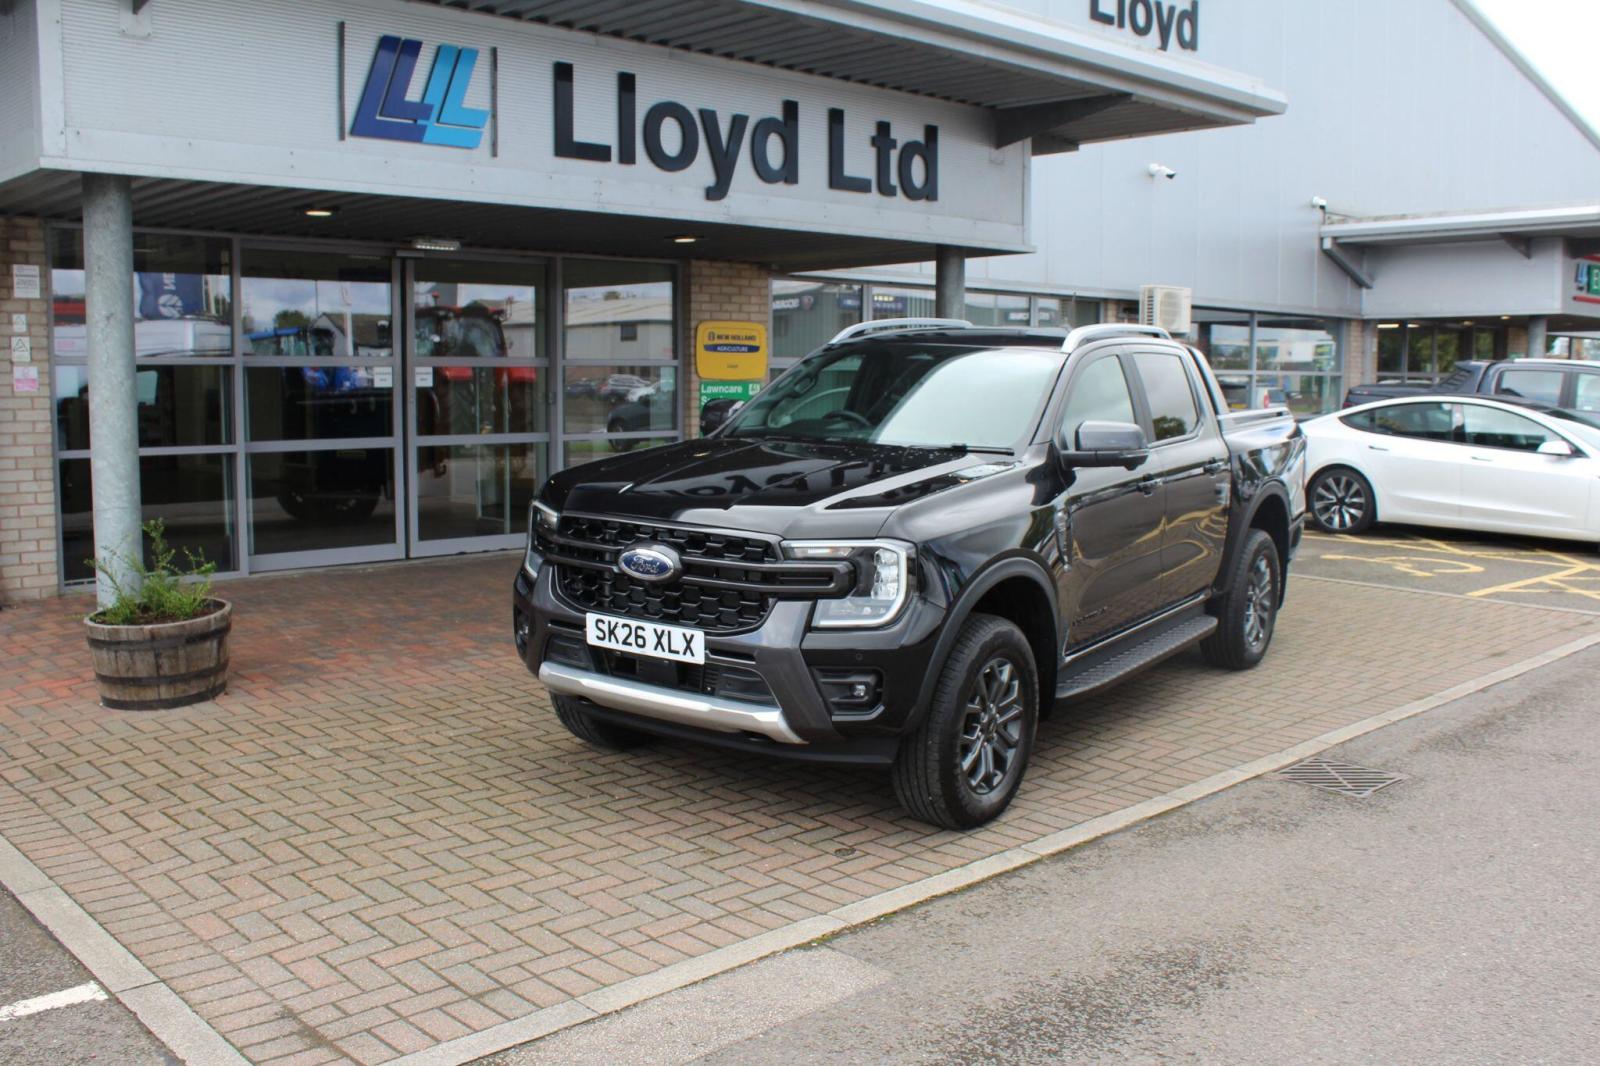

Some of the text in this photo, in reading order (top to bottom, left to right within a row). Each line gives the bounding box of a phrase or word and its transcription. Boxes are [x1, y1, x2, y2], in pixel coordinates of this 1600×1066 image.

[553, 61, 938, 201] Lloyd Ltd
[731, 334, 757, 342] HOLLAND
[701, 384, 743, 394] Lawncare
[595, 618, 695, 657] SK26 XLX
